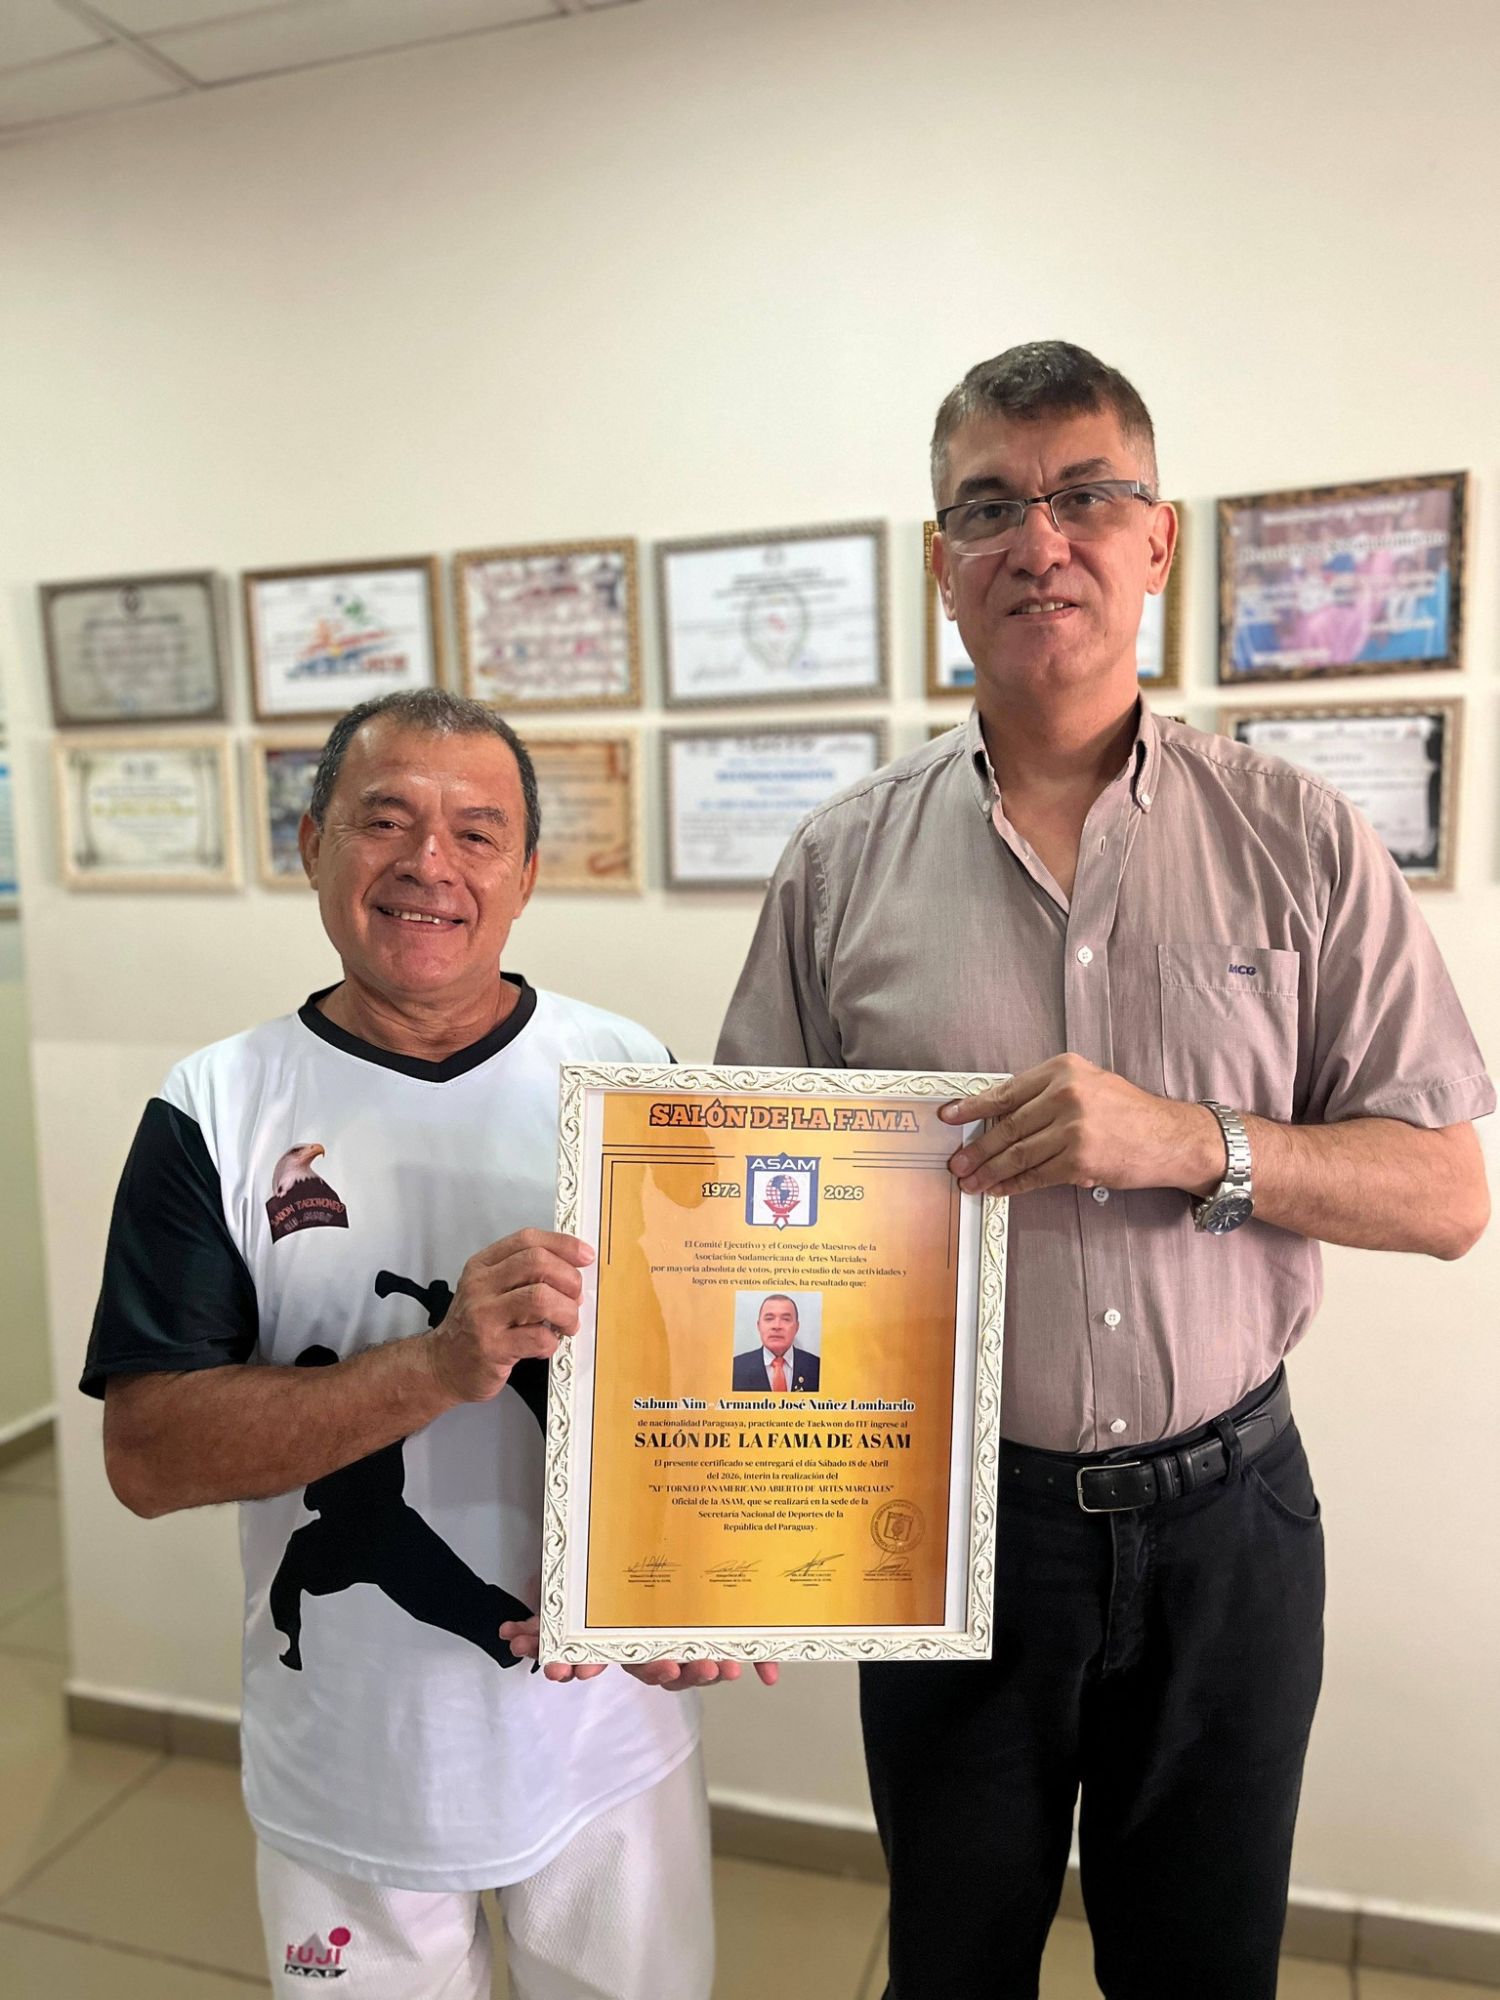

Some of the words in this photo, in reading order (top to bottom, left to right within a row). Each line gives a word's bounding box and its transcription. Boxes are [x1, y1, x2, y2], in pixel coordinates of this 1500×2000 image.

[650, 1098, 747, 1128] SALÓN
[750, 1107, 788, 1129] DE
[791, 1108, 830, 1131] LA
[834, 1109, 919, 1132] FAMA
[750, 1158, 816, 1171] ASAM
[702, 1183, 741, 1198] 1972
[824, 1185, 864, 1200] 2026
[684, 1240, 692, 1248] El
[693, 1240, 721, 1249] Comité
[724, 1240, 760, 1250] Ejecutivo
[761, 1242, 766, 1250] y
[768, 1241, 775, 1249] el
[777, 1241, 808, 1251] Consejo
[821, 1243, 857, 1251] Maestros
[858, 1243, 868, 1251] de
[869, 1243, 877, 1251] la
[694, 1252, 736, 1261] Asociación
[738, 1253, 794, 1262] Sudamericana
[796, 1254, 805, 1262] de
[808, 1254, 829, 1263] Artes
[830, 1254, 867, 1263] Marciales
[650, 1265, 664, 1273] por
[701, 1264, 735, 1273] absoluta
[736, 1265, 747, 1273] de
[774, 1267, 800, 1275] previo
[801, 1266, 830, 1275] estudio
[831, 1267, 841, 1275] de
[857, 1267, 901, 1276] actividades
[902, 1269, 907, 1277] y
[692, 1277, 717, 1286] logros
[730, 1278, 761, 1286] eventos
[762, 1277, 798, 1287] oficiales,
[811, 1279, 848, 1287] resultado
[849, 1281, 867, 1289] que:
[634, 1397, 678, 1409] Sabum
[681, 1398, 707, 1409] Nim
[718, 1398, 776, 1410] Armando
[778, 1398, 806, 1410] José
[850, 1399, 915, 1411] Lombardo
[649, 1419, 700, 1428] nacionalidad
[702, 1420, 746, 1429] Paraguaya,
[748, 1420, 793, 1429] practicante
[795, 1420, 805, 1428] de
[807, 1420, 843, 1428] Taekwon
[844, 1420, 855, 1428] do
[870, 1421, 899, 1430] ingrese
[634, 1429, 699, 1448] SALÓN
[704, 1433, 730, 1448] DE
[738, 1433, 763, 1448] LA
[767, 1433, 822, 1448] FAMA
[826, 1433, 853, 1449] DE
[856, 1433, 911, 1449] ASAM
[664, 1460, 698, 1468] presente
[700, 1459, 743, 1467] certificado
[755, 1459, 794, 1468] entregará
[818, 1460, 847, 1468] Sábado
[706, 1472, 720, 1480] del
[781, 1472, 824, 1480] realización
[826, 1472, 838, 1480] del
[720, 1498, 745, 1506] ASAM,
[747, 1499, 761, 1507] que
[773, 1497, 809, 1505] realizará
[788, 1511, 823, 1520] Deportes
[723, 1523, 763, 1532] República
[286, 1944, 341, 1965] FUJI
